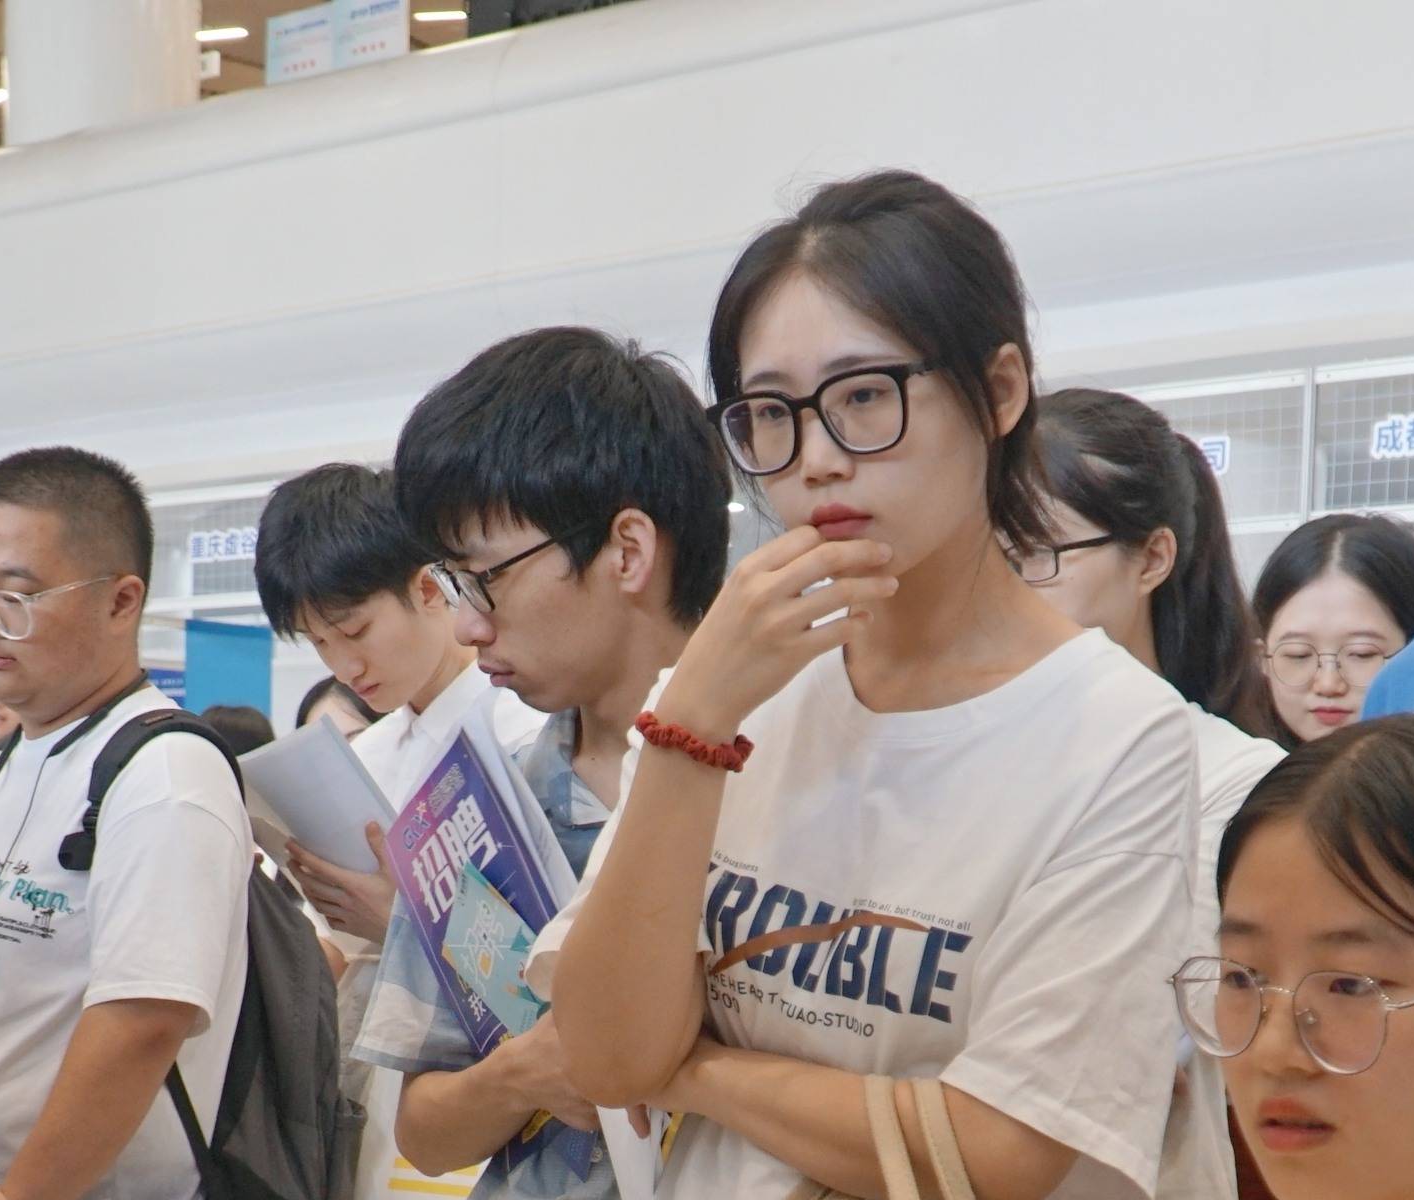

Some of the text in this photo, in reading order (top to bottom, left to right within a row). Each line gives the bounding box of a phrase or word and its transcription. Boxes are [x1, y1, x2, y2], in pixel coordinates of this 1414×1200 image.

[409, 794, 500, 924] 招聘
[724, 854, 760, 873] business
[894, 904, 910, 916] but
[911, 907, 937, 923] trust
[938, 915, 955, 929] not
[956, 919, 972, 932] all
[707, 861, 974, 1024] ROUBLE
[780, 998, 875, 1038] TUAO-STUDIO
